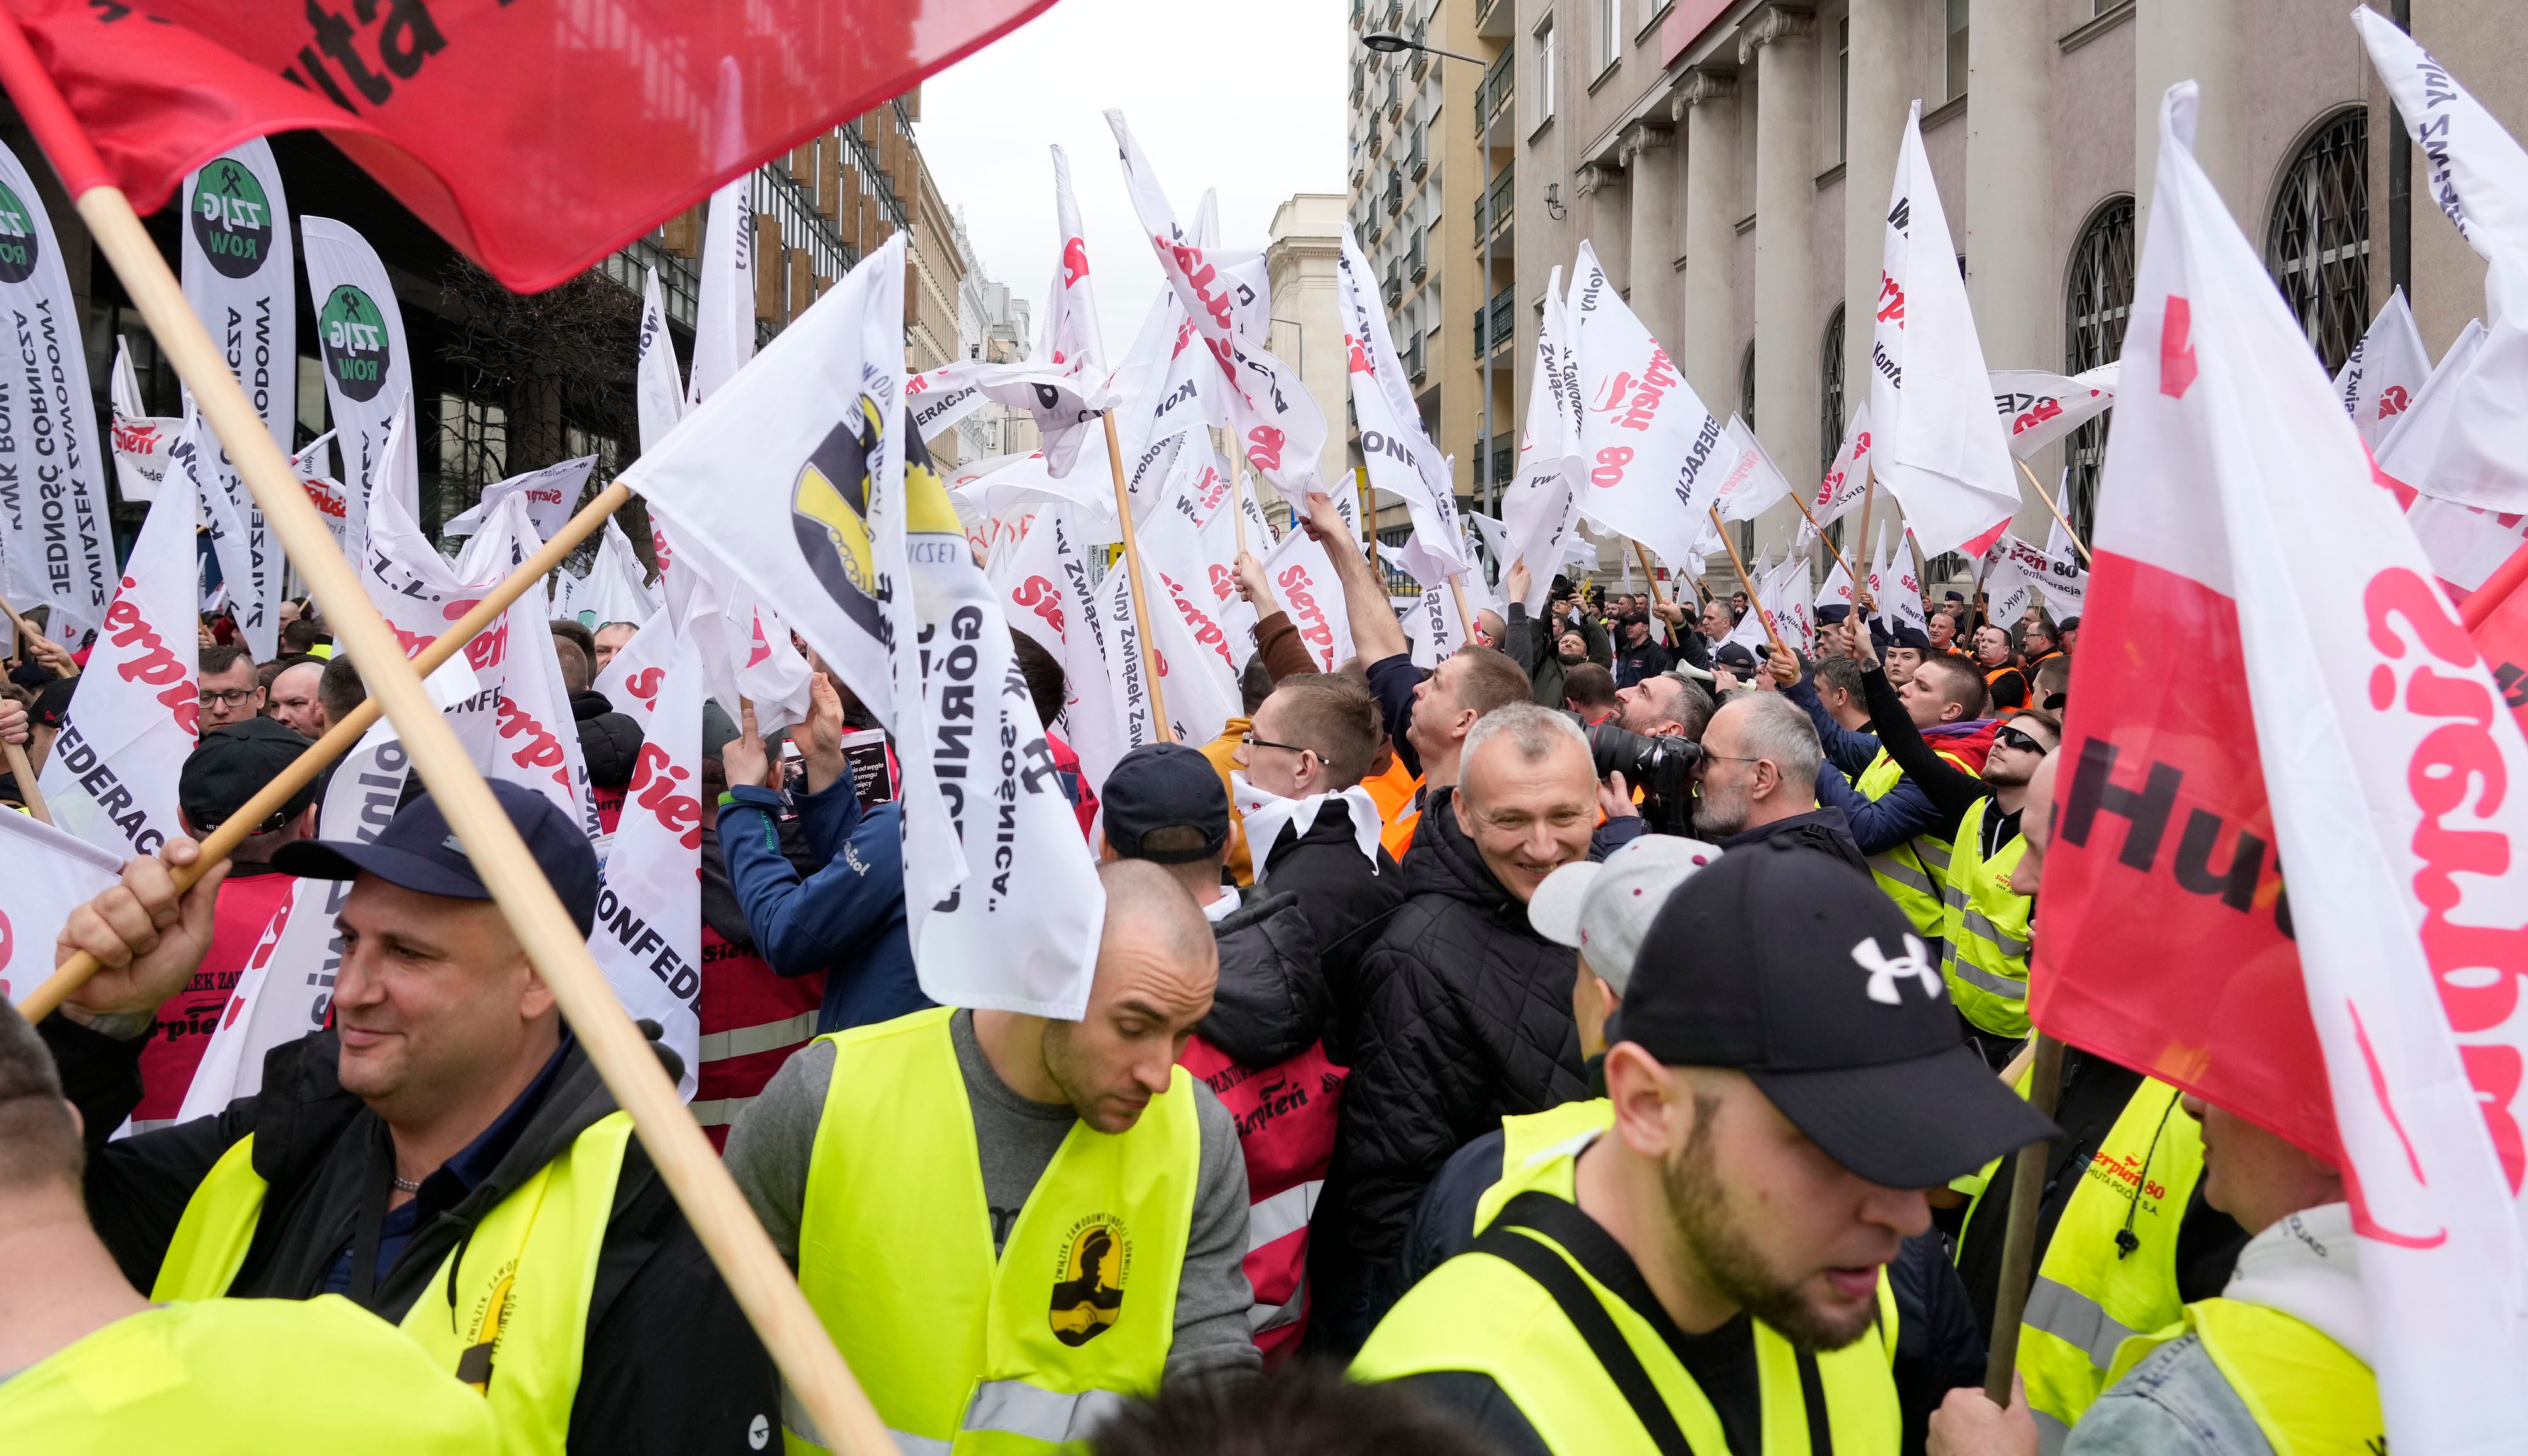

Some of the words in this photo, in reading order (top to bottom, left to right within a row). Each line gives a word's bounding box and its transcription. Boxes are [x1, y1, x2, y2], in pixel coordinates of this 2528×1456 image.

[2053, 561, 2079, 578] 80
[1120, 625, 1143, 708] Związek
[866, 762, 884, 772] węgla
[857, 772, 877, 782] smogu
[1234, 1081, 1309, 1138] ierpień
[2145, 1180, 2165, 1200] 80
